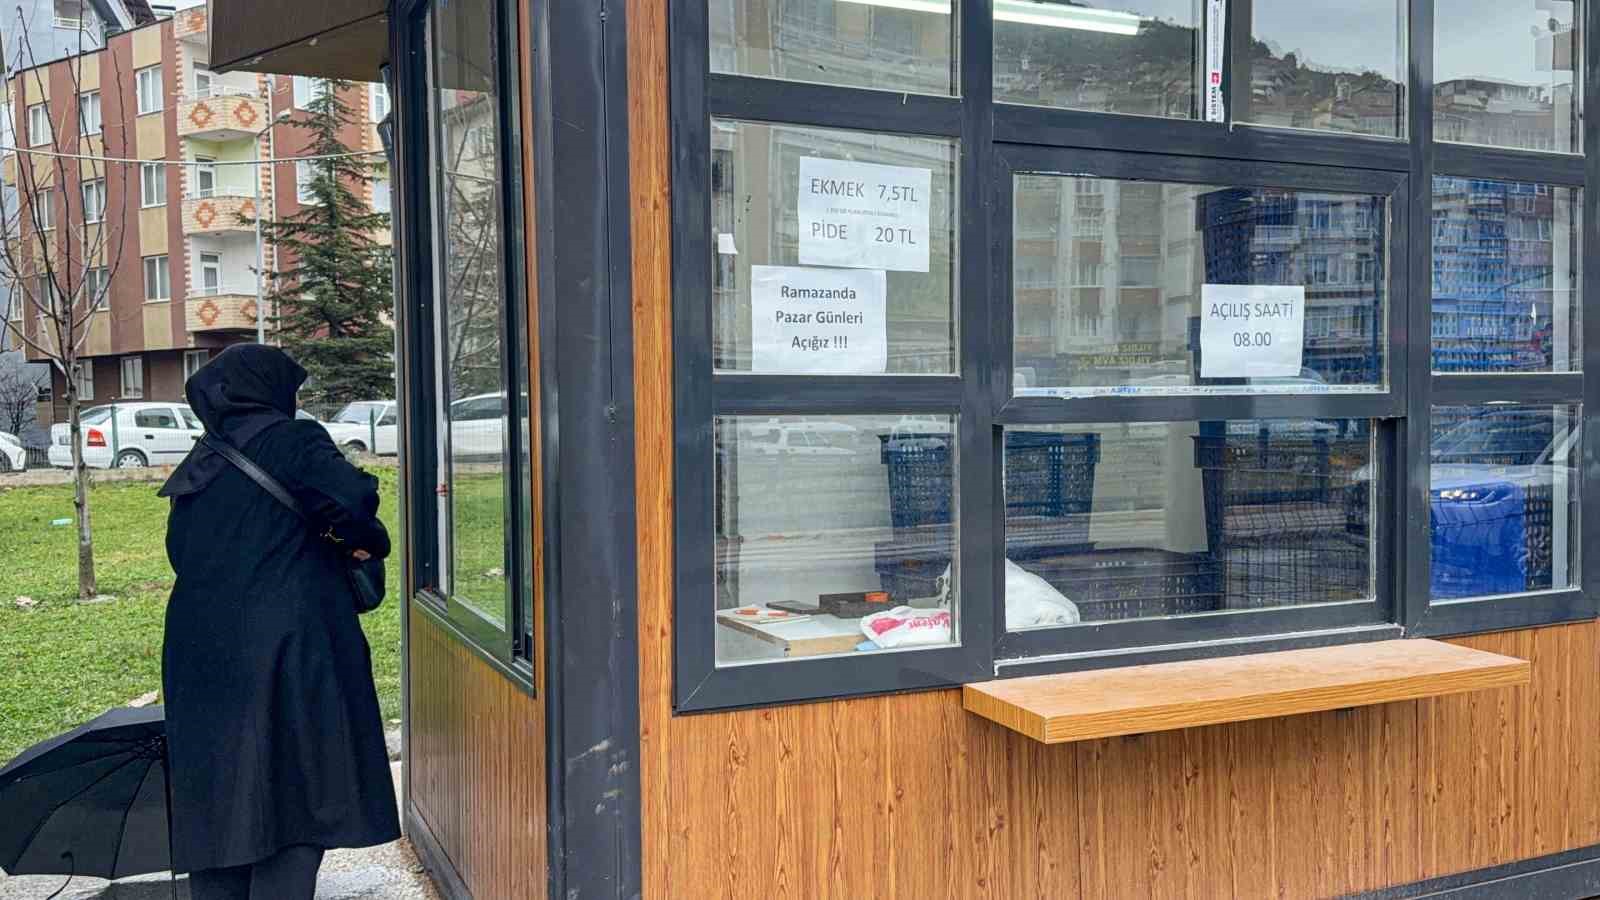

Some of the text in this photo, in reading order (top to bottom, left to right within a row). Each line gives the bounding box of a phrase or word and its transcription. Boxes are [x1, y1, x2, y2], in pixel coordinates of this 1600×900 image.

[809, 177, 918, 203] EKMEK 7,5TL
[811, 219, 916, 245] PİDE 20 TL
[780, 285, 857, 300] Ramazanda
[775, 310, 863, 325] Pazar Günleri
[1210, 298, 1294, 320] AÇILIŞ SAATİ
[791, 335, 848, 352] Açığız !!!
[1233, 331, 1272, 348] 08.00
